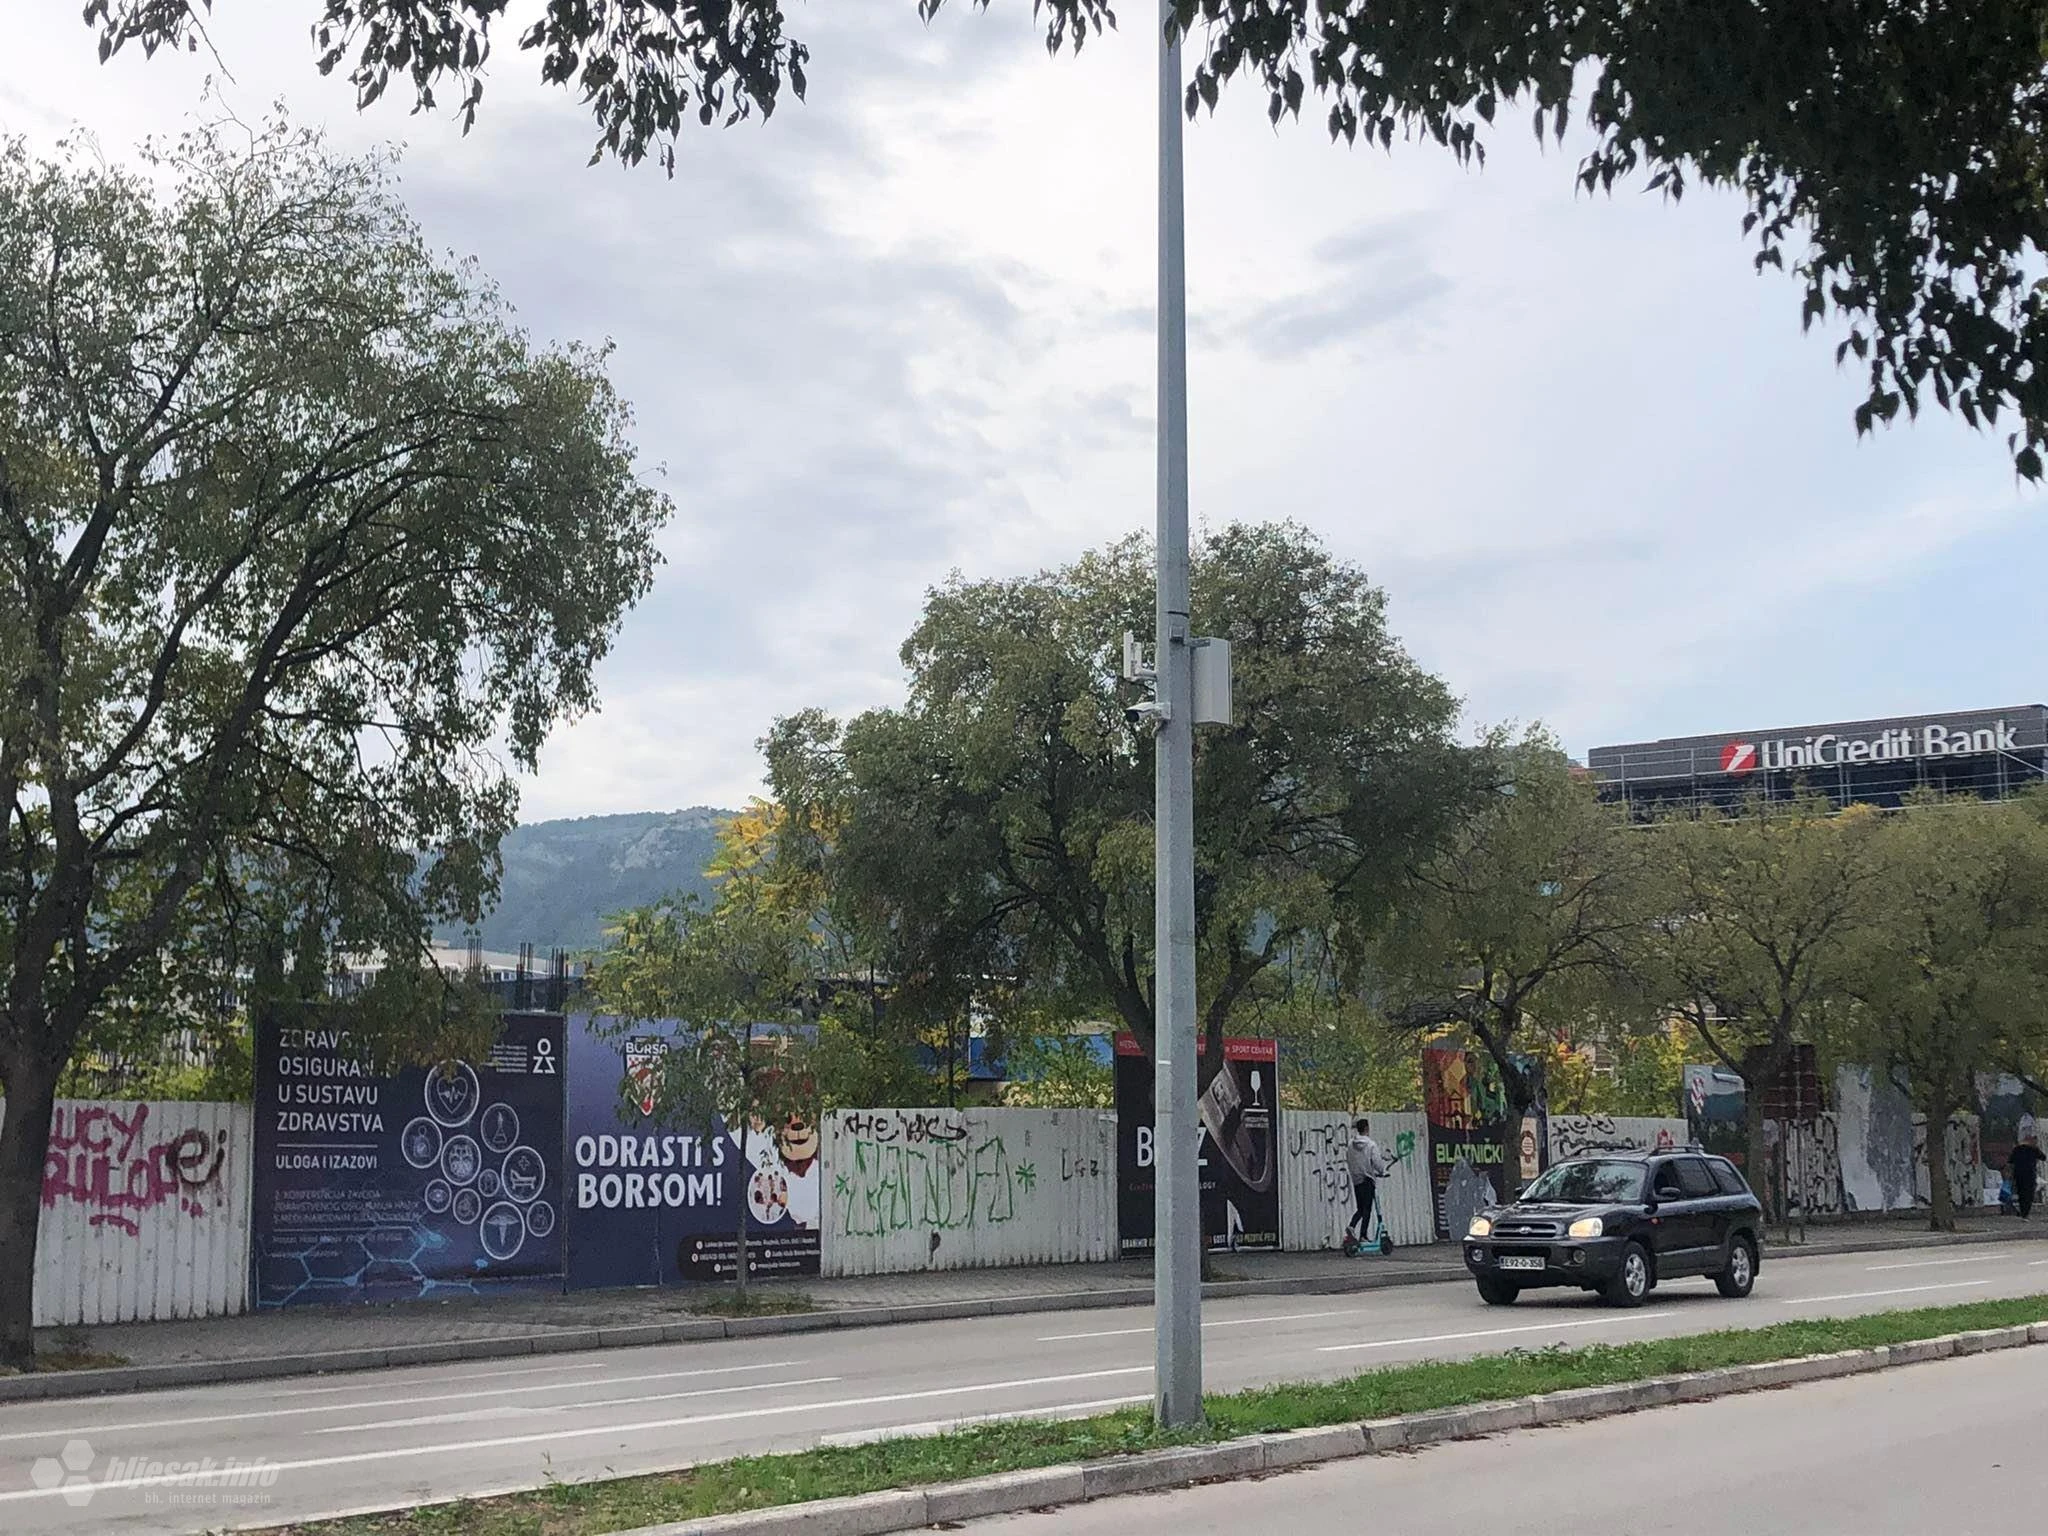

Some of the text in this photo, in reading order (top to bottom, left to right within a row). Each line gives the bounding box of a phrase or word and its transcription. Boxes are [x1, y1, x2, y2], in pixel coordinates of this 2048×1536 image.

[1761, 719, 2017, 771] UniCredit Bank
[625, 1042, 669, 1055] BORSA
[278, 1084, 379, 1106] U SUSTAVU
[276, 1111, 385, 1133] ZDRAVSTVA
[276, 1154, 320, 1169] ULOGA
[329, 1153, 378, 1169] IZAZOVI
[574, 1134, 725, 1168] ODRASTI S
[577, 1171, 723, 1210] BORSOM!
